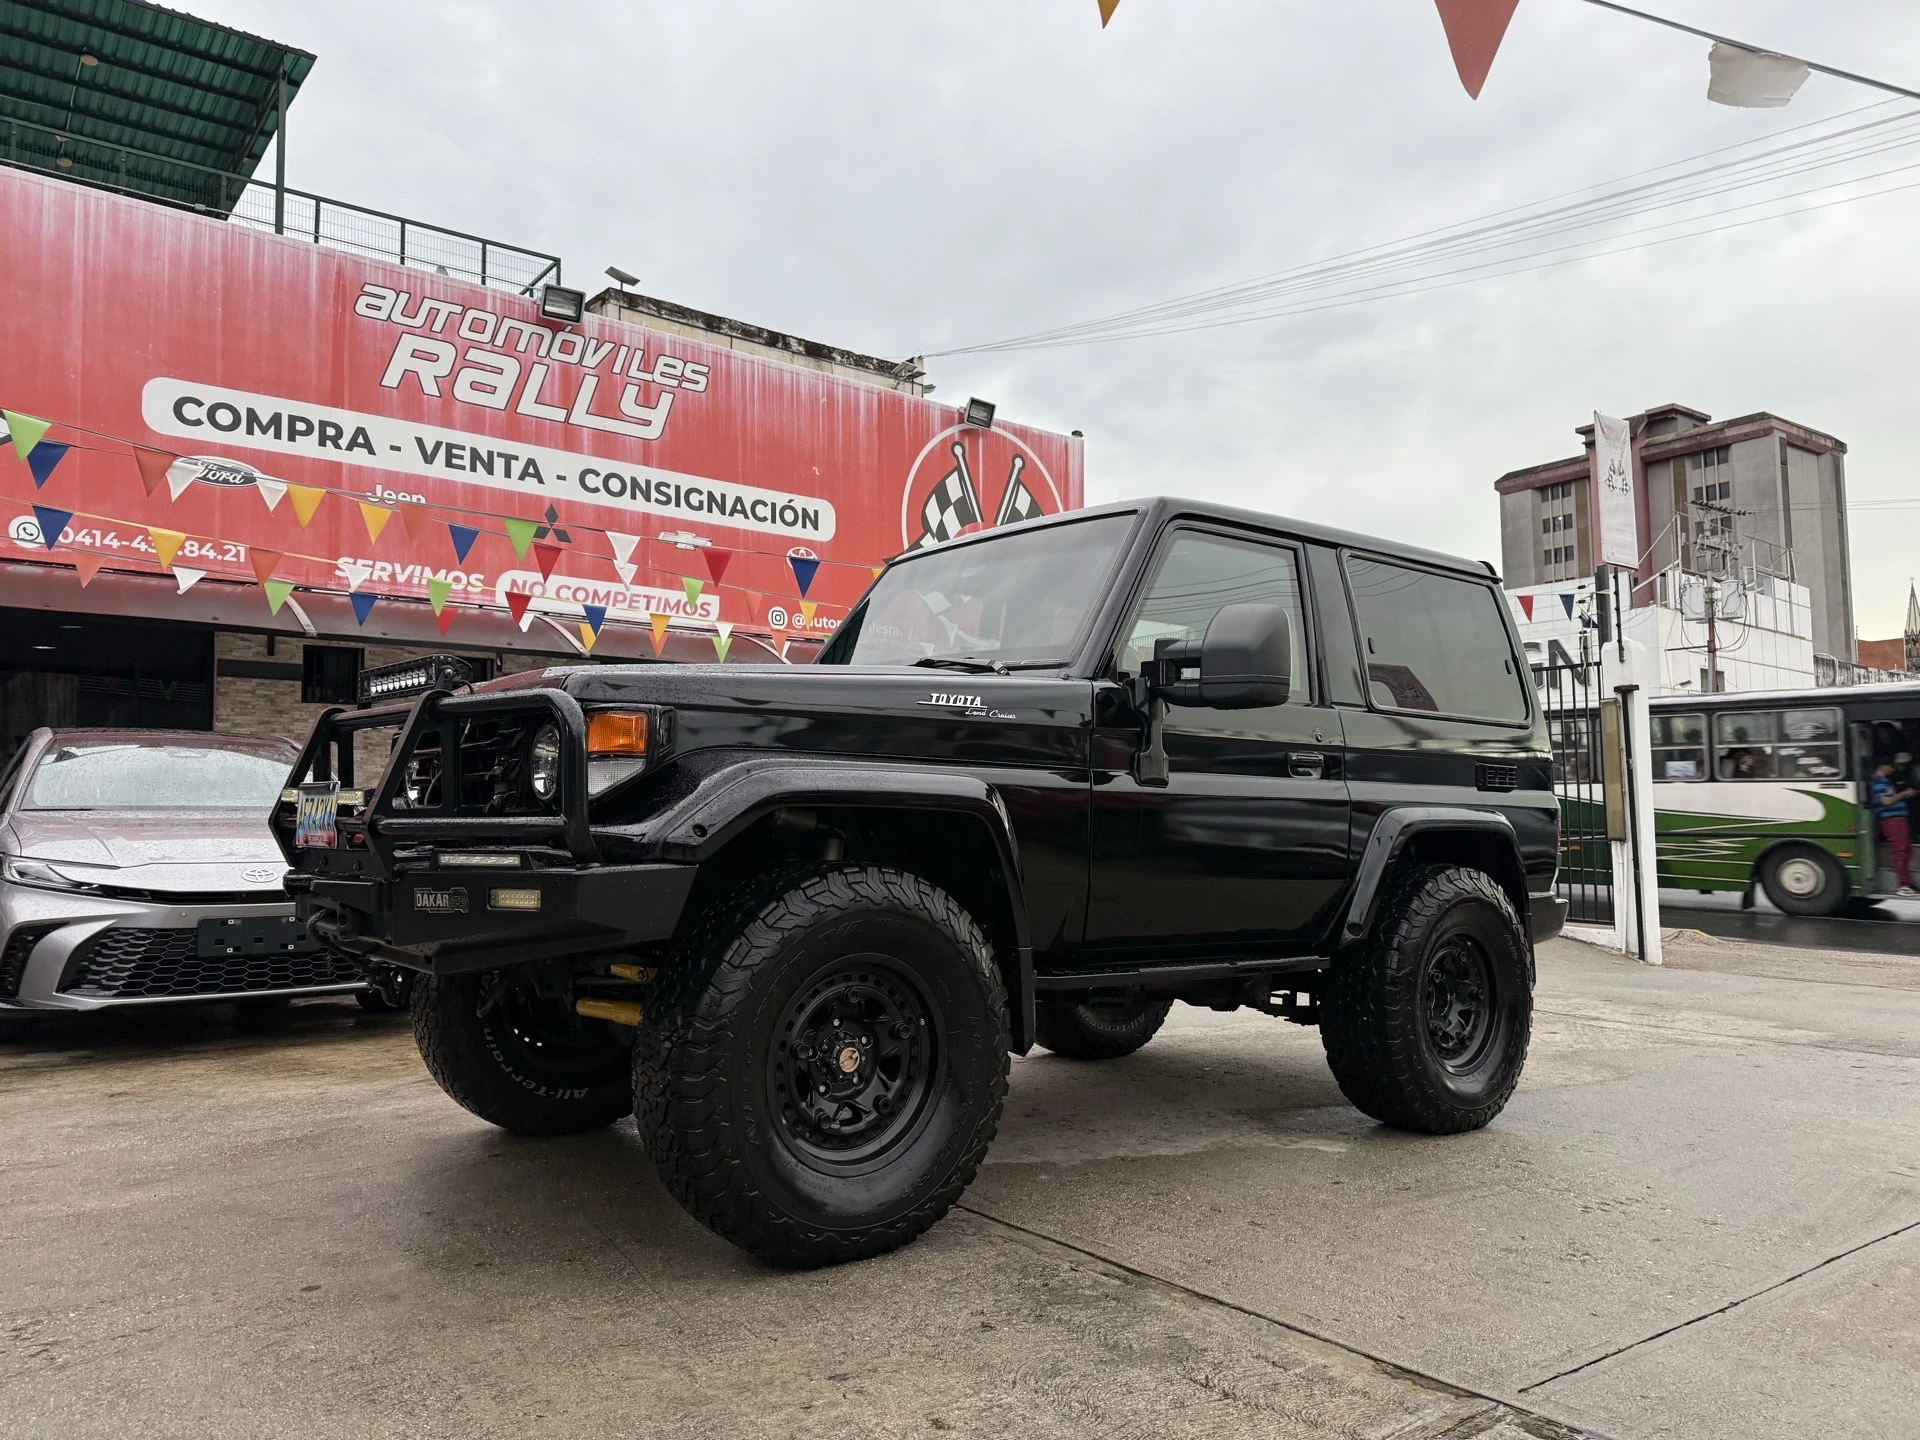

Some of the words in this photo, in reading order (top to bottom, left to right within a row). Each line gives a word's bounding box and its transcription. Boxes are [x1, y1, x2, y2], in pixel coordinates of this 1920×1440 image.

[172, 396, 376, 456] COMPRA
[414, 436, 546, 485] VENTA
[578, 467, 820, 531] CONSIGNACIÓN
[195, 460, 245, 484] Ford
[509, 578, 547, 598] NO
[555, 584, 712, 618] COMPETIMOS
[930, 693, 981, 707] TOYOTA
[989, 710, 1017, 719] Cruiser
[416, 893, 450, 908] DAKAR
